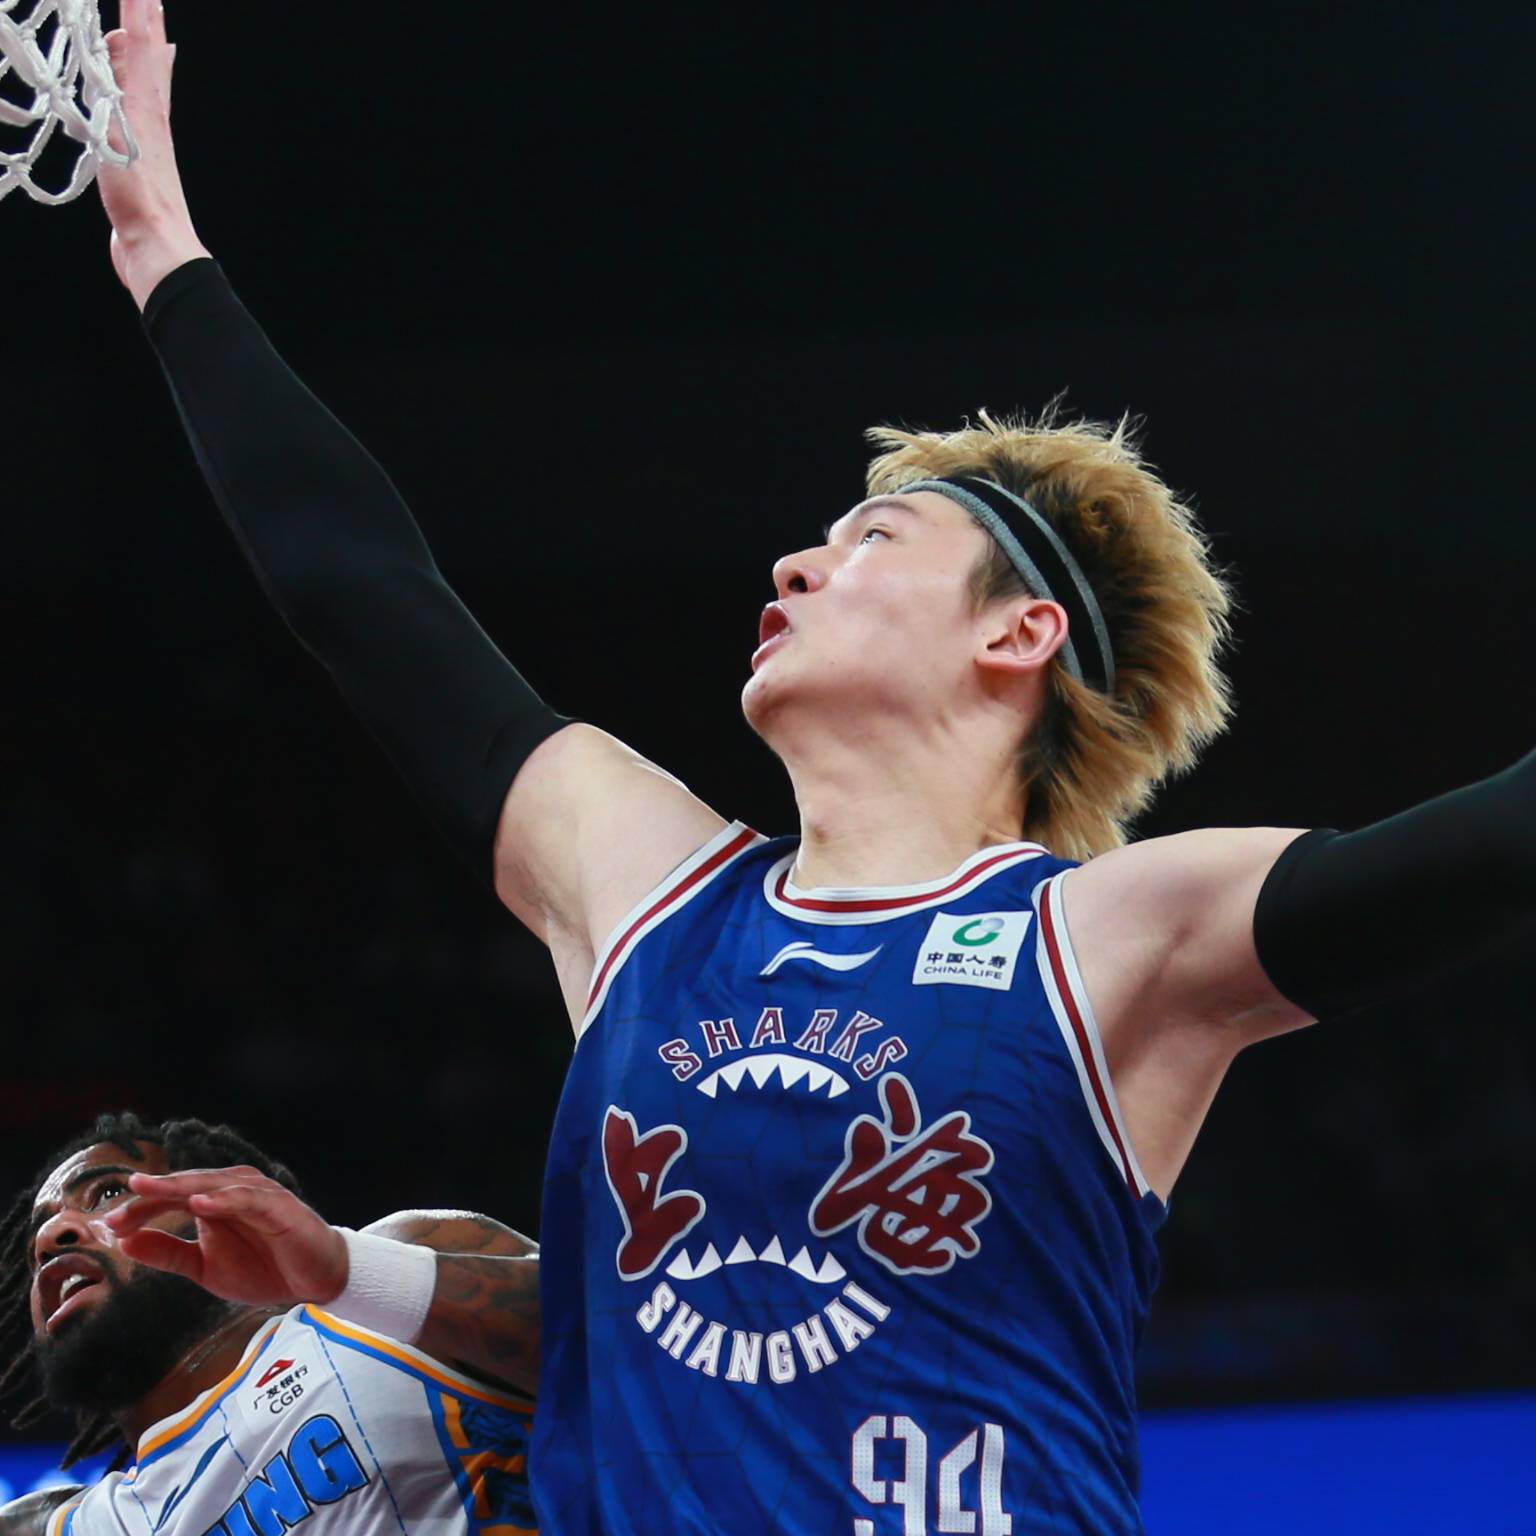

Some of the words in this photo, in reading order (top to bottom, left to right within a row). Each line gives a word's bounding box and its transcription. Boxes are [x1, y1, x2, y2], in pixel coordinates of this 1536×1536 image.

[924, 966, 967, 975] CHINA
[972, 969, 1003, 980] LIFE
[927, 951, 1007, 969] 中国人寿
[657, 1005, 909, 1081] SHARKS
[636, 1280, 892, 1385] SHANGHAI
[253, 1364, 308, 1410] 广发银行
[269, 1383, 304, 1414] CGB
